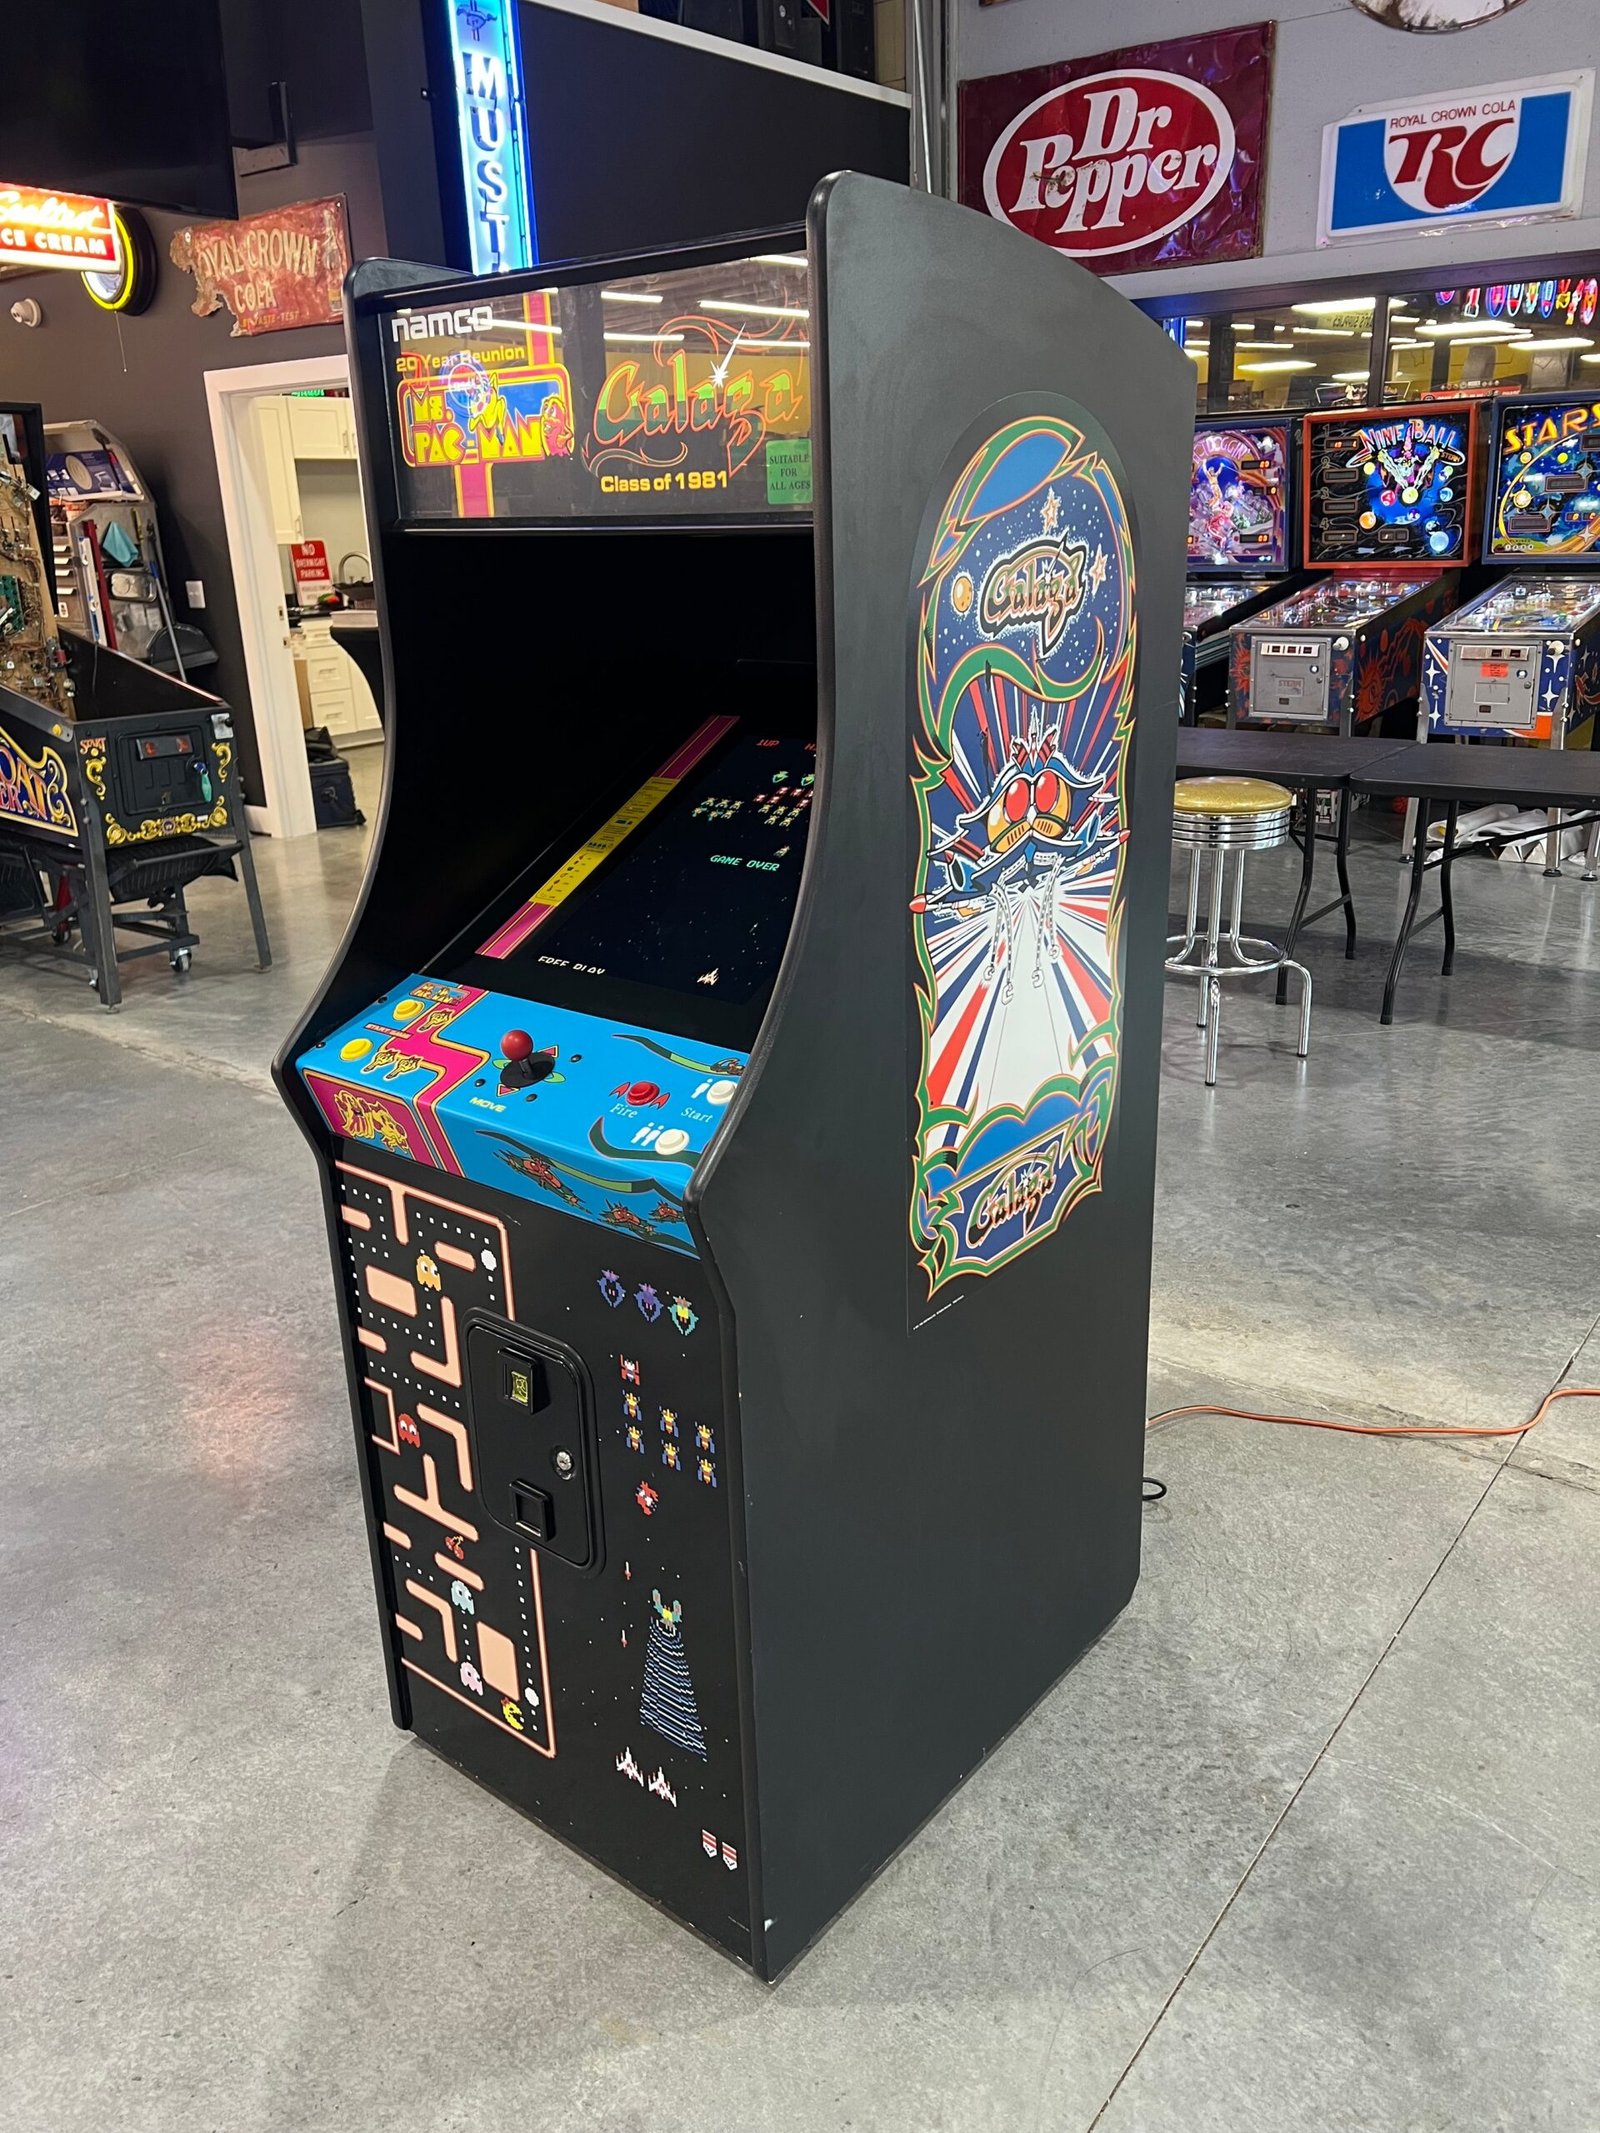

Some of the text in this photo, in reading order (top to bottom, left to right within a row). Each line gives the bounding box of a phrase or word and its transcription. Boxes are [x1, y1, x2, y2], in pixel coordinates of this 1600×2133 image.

[1072, 87, 1172, 160] Dr
[1389, 99, 1516, 128] ROYAL CROWN COLA
[462, 52, 511, 273] MUST
[1388, 117, 1514, 209] RC
[1009, 134, 1217, 234] Pepper
[34, 232, 107, 255] CREAM
[246, 228, 319, 278] CROWN
[234, 279, 277, 313] COLA
[391, 305, 494, 343] namco
[396, 345, 525, 372] 20 Year Reunion
[593, 348, 803, 480] Galaga
[412, 412, 545, 465] PAC-MAN
[1352, 419, 1457, 452] NINE BALL
[769, 453, 810, 464] SUITABLE
[780, 467, 798, 477] FOR
[600, 470, 728, 492] Class of 1981
[771, 480, 811, 491] ALL AGES
[301, 543, 316, 556] NO
[80, 737, 106, 754] START
[710, 854, 780, 872] GAME OVER
[469, 1096, 507, 1113] MOVE
[609, 1103, 638, 1119] Fire
[681, 1107, 714, 1123] Start
